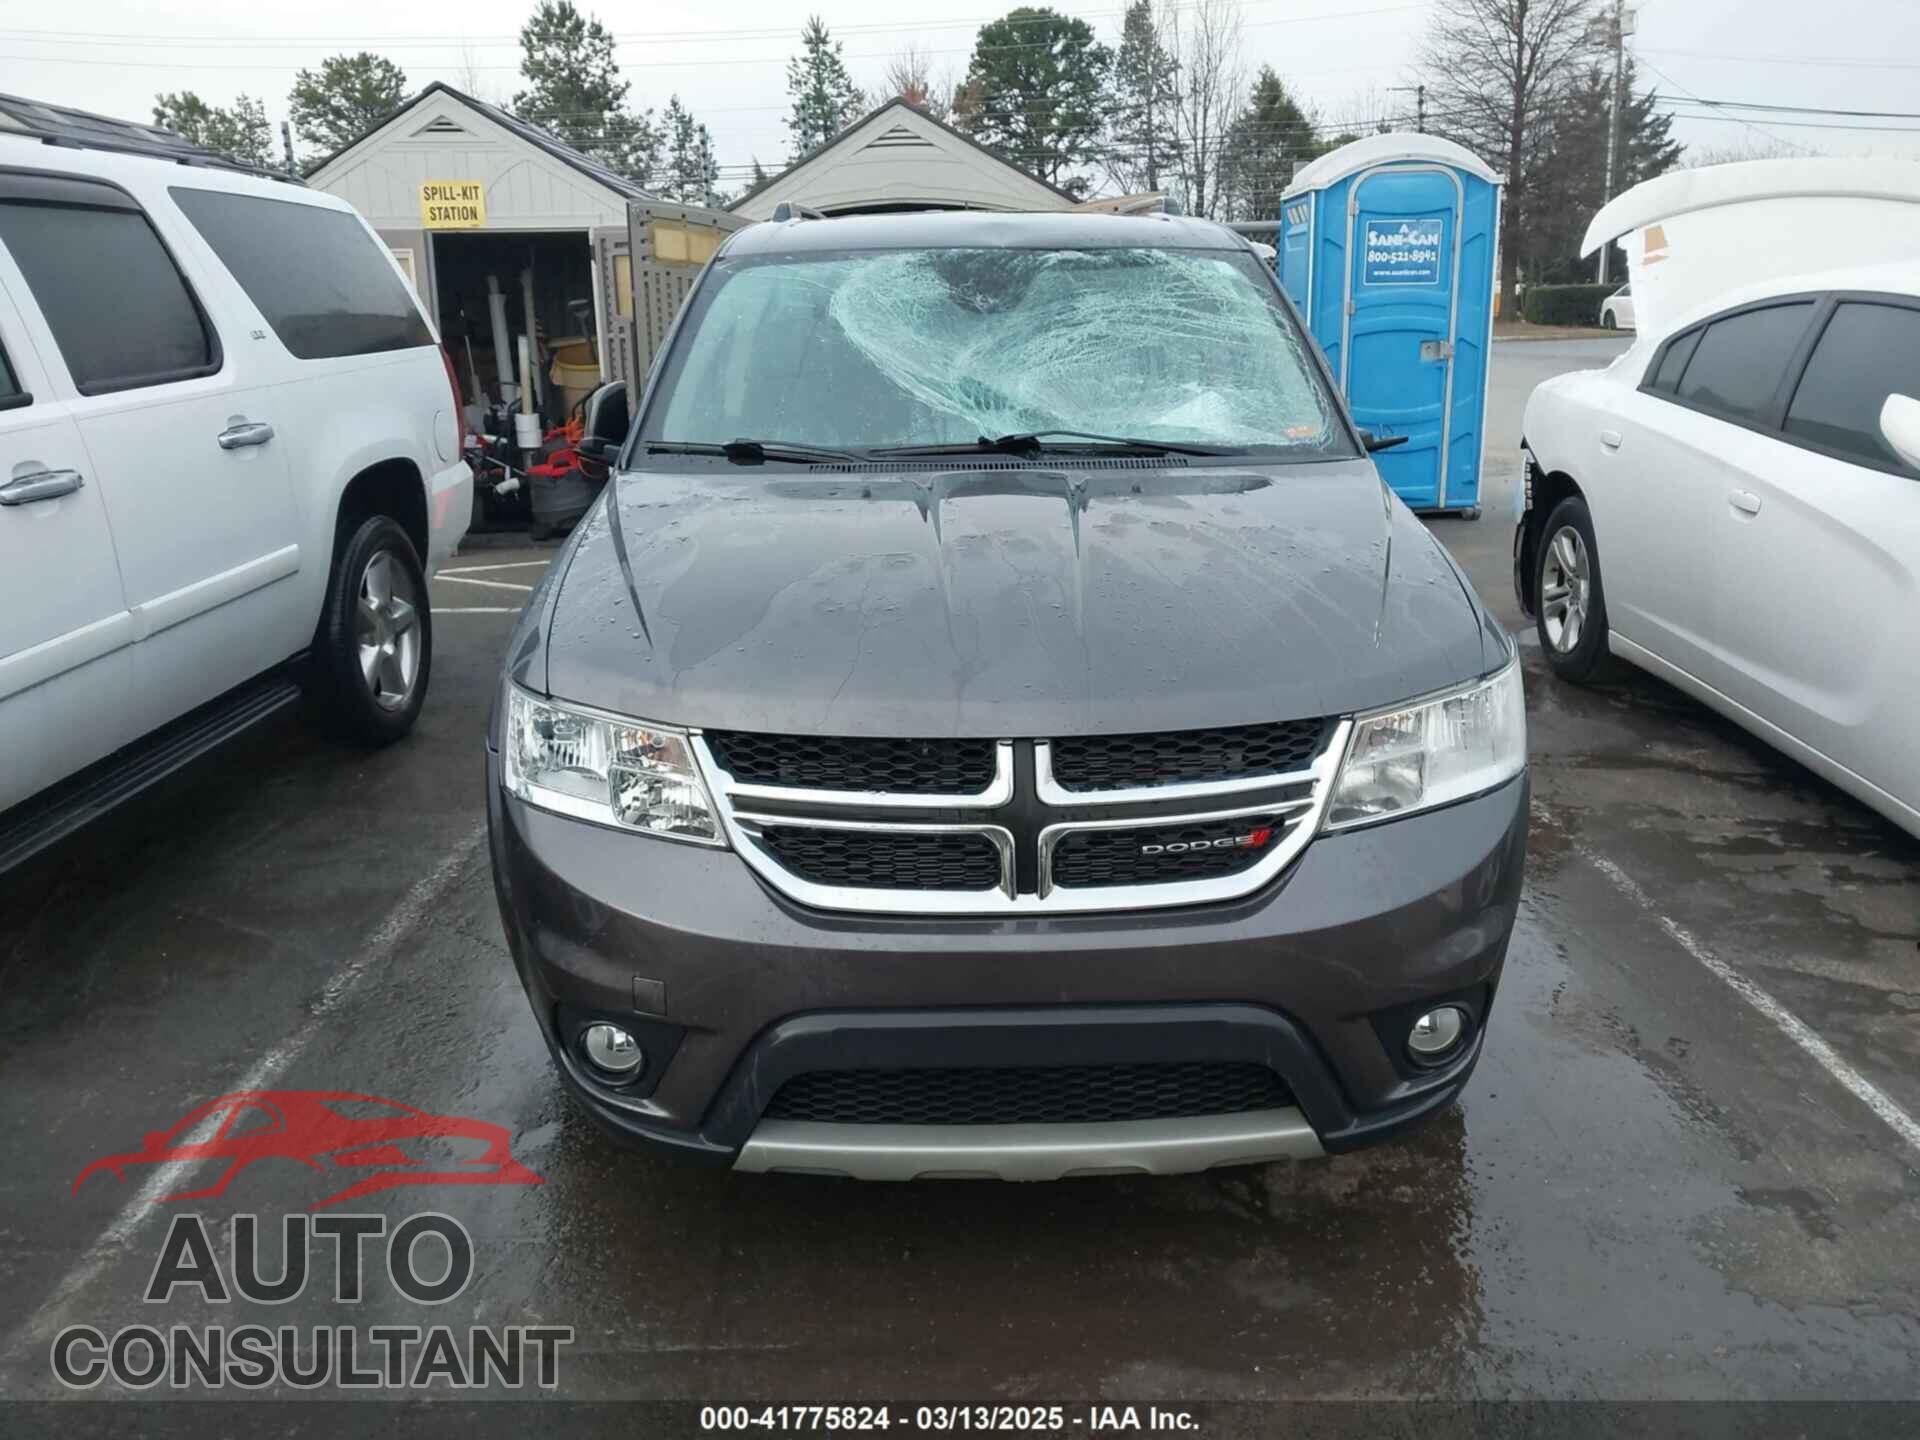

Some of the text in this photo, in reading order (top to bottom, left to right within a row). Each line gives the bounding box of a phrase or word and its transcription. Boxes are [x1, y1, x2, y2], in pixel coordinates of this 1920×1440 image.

[423, 185, 480, 201] SPILL-KIT
[429, 206, 478, 221] STATION
[1368, 249, 1436, 264] 800-521-8941
[1142, 834, 1254, 855] DODGE
